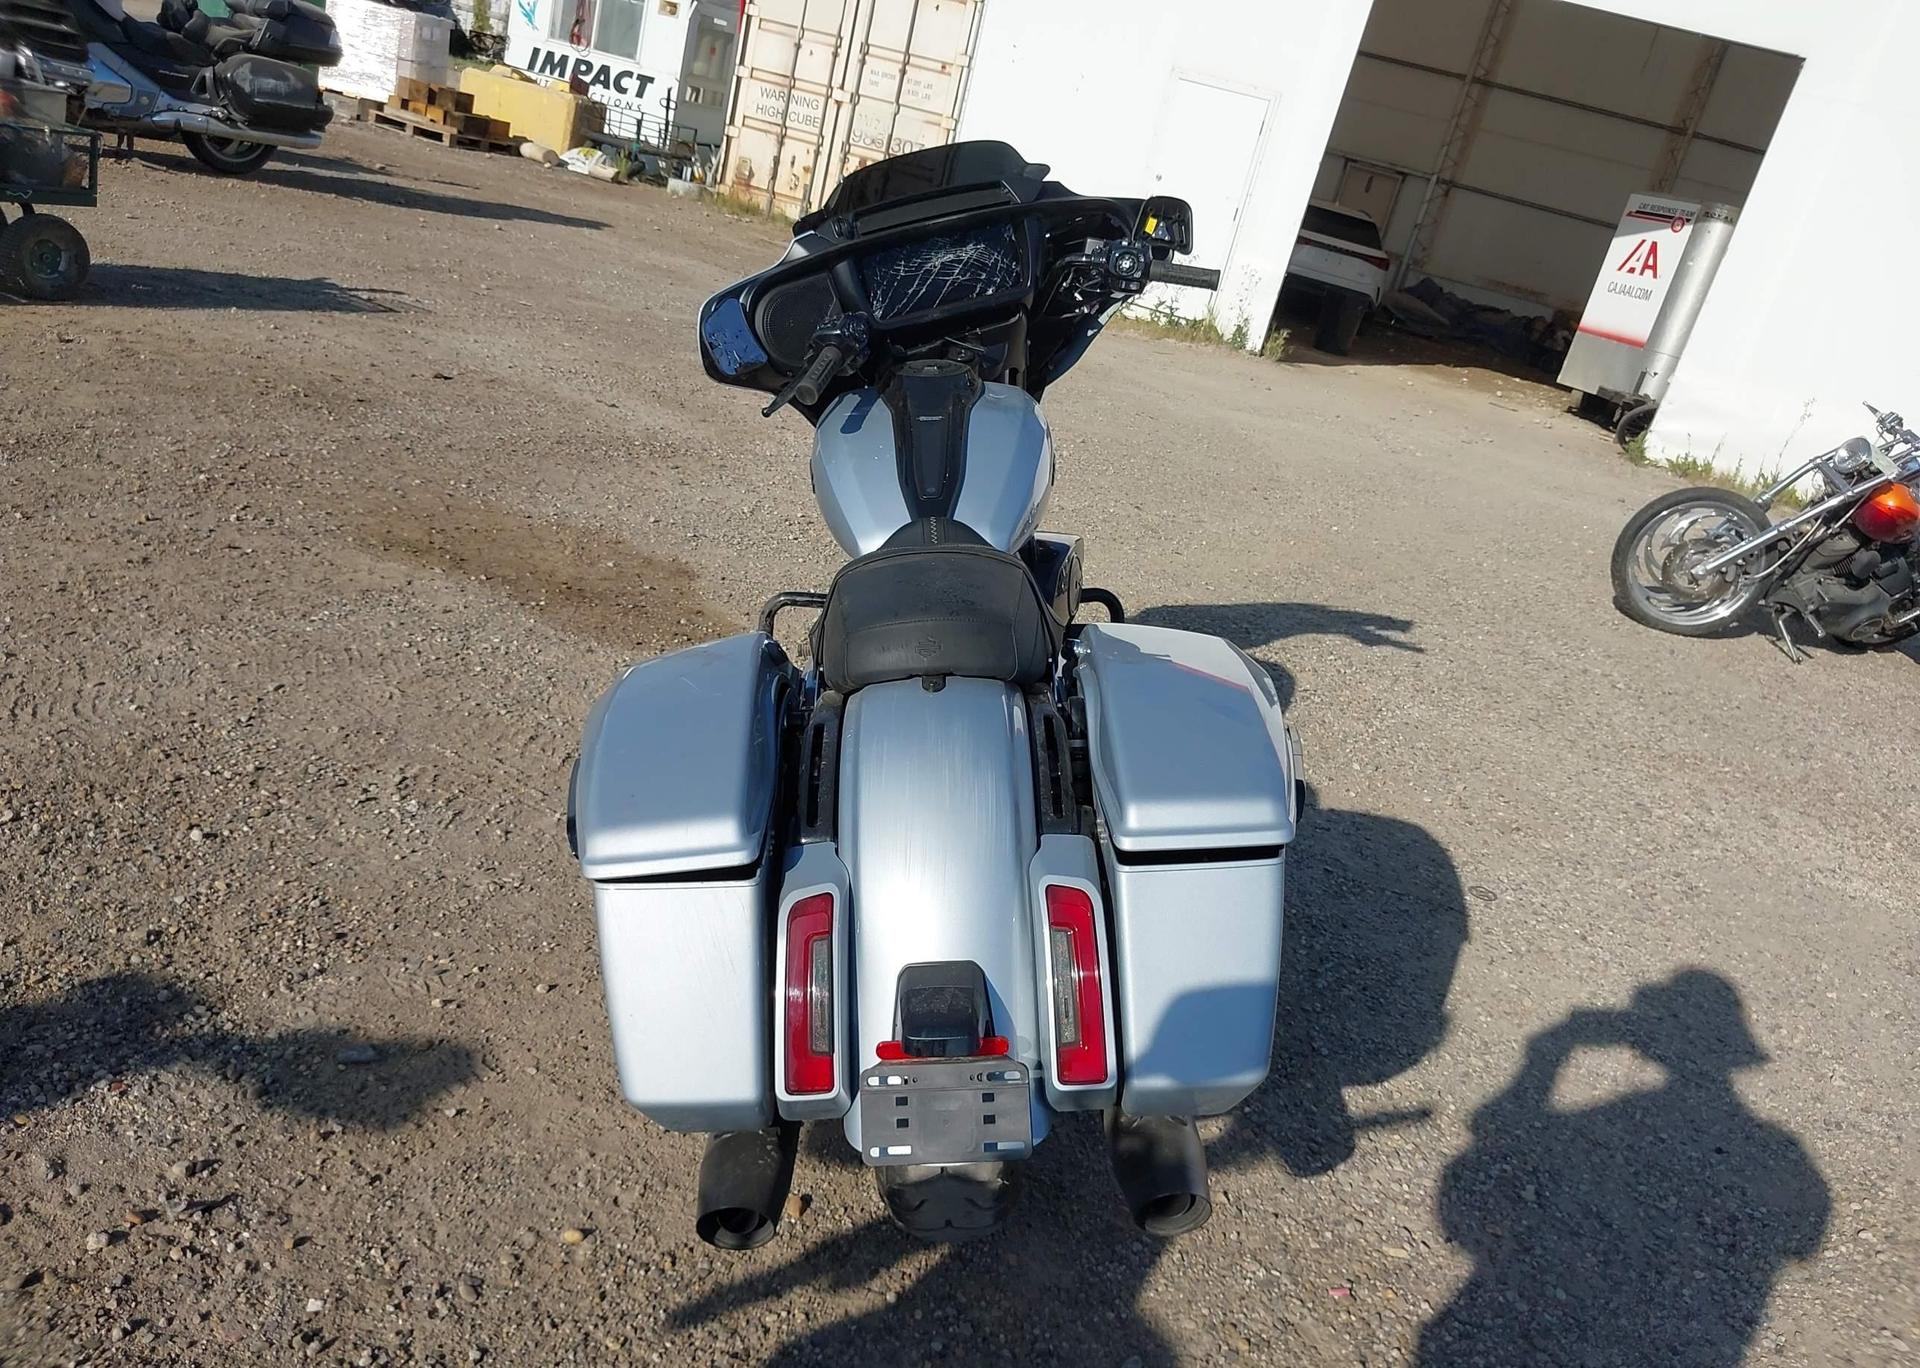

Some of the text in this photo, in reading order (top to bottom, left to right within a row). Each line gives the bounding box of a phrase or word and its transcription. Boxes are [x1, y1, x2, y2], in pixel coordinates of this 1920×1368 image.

[527, 47, 655, 99] IMPACT
[590, 91, 642, 111] CTIONS
[760, 86, 820, 111] WARNING
[755, 103, 820, 129] HIGH CUBE
